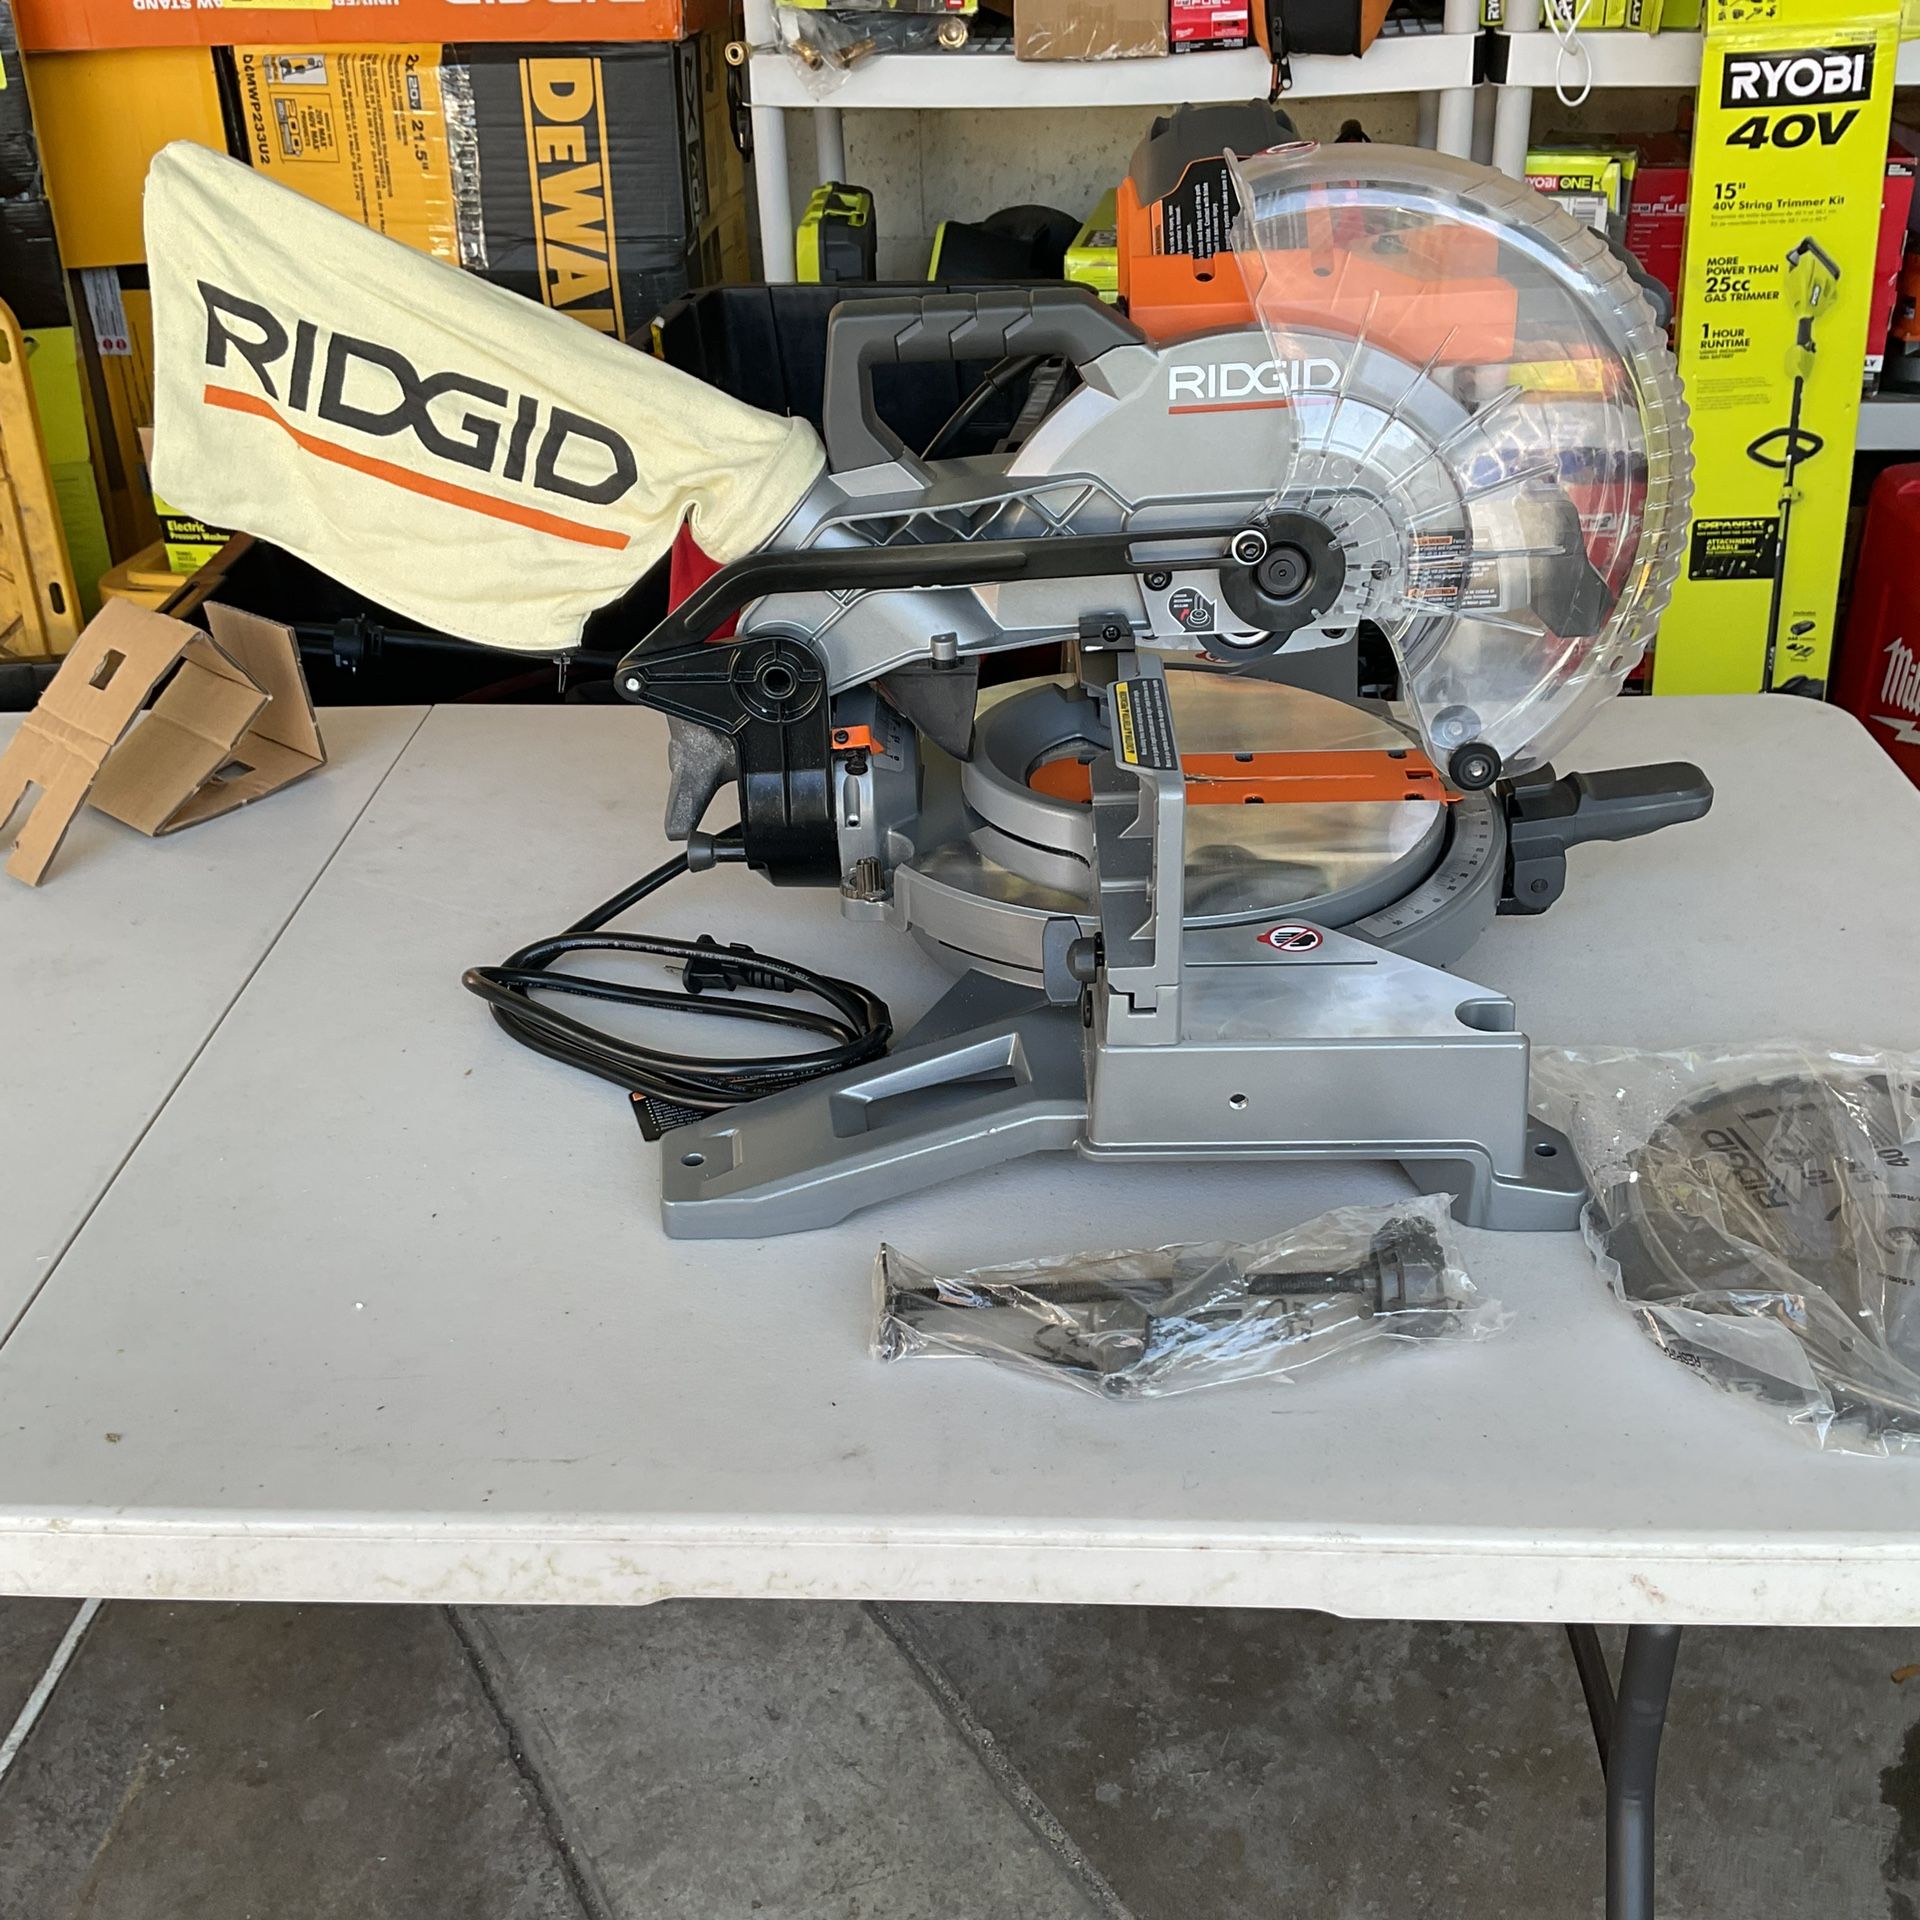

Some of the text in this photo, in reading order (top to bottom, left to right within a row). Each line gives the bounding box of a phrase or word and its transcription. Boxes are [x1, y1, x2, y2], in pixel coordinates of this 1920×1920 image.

[1730, 53, 1866, 100] RYOBI
[1726, 109, 1861, 149] 40V
[1714, 182, 1746, 200] 15"
[1713, 196, 1845, 211] 40V String Trimmer Kit
[1707, 256, 1739, 266] MORE
[1706, 264, 1779, 276] POWER THAN
[1706, 276, 1750, 293] 25cc
[1704, 291, 1780, 303] GAS TRIMMER
[1702, 322, 1745, 338] 1 HOUR
[1700, 338, 1750, 349] RUNTIME
[1168, 358, 1341, 400] RIDGID
[197, 279, 638, 505] RIDGID
[166, 520, 206, 532] Electric
[170, 532, 200, 540] Pressure
[1881, 637, 1920, 716] Mil
